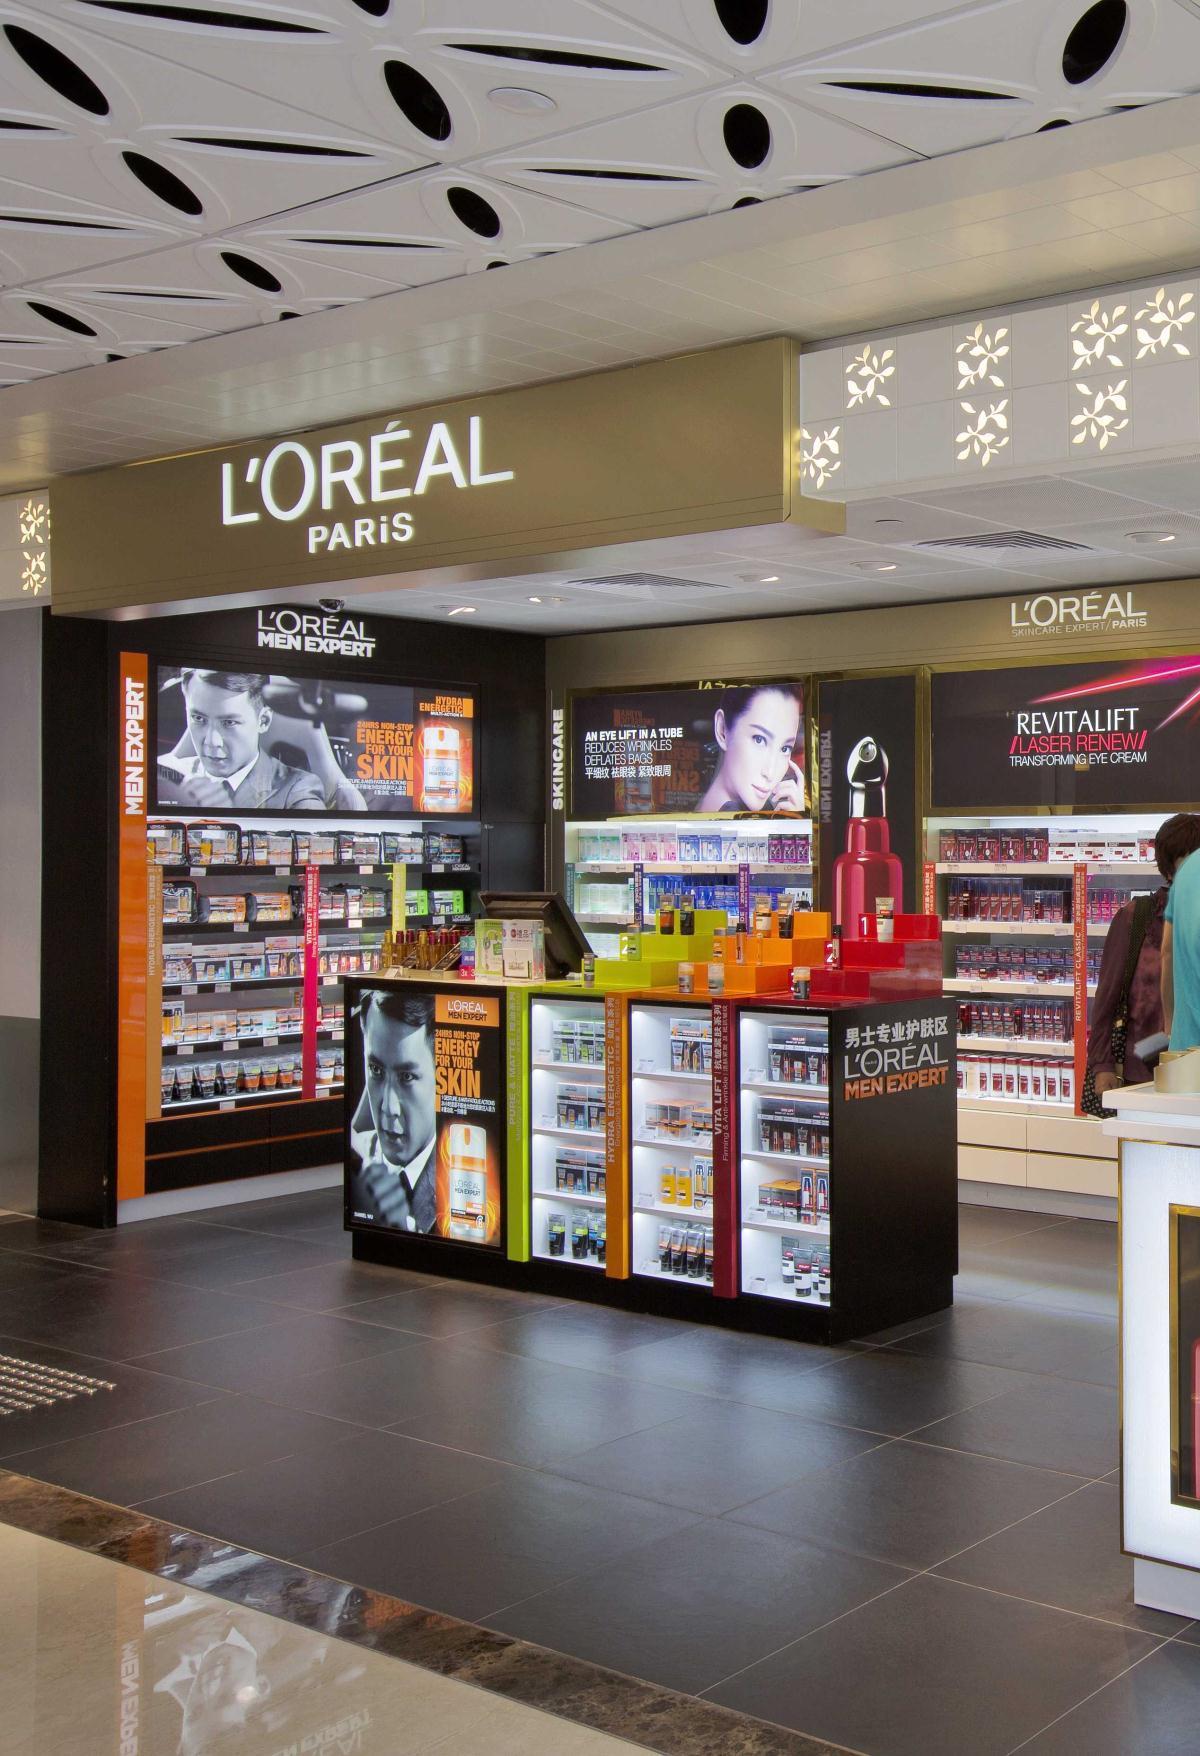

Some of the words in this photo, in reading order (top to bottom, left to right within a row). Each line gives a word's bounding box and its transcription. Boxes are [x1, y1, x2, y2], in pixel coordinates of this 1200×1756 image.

[222, 416, 514, 525] L'ORÉAL
[1011, 592, 1147, 627] L'ORÉAL
[258, 610, 376, 641] L'ORÉAL
[1012, 626, 1062, 638] SKINCARE
[258, 632, 301, 650] MEN
[305, 636, 376, 658] EXPERT
[420, 703, 463, 713] ENERGETIC
[436, 696, 463, 705] HYDRA
[126, 678, 144, 762] EXPERT
[381, 722, 413, 730] NON-STOP
[1018, 708, 1139, 734] REVITALIFT
[357, 729, 413, 745] ENERGY
[585, 732, 597, 741] AN
[600, 731, 616, 740] EYE
[619, 730, 637, 740] LIFT
[639, 730, 648, 739] IN
[650, 729, 657, 738] A
[659, 728, 683, 738] TUBE
[366, 745, 385, 755] FOR
[388, 746, 413, 756] YOUR
[585, 742, 625, 753] REDUCES
[627, 740, 671, 751] WRINKLES
[357, 754, 413, 780] SKIN
[553, 709, 563, 810] SKINCARE
[585, 754, 626, 766] DEFLATES
[629, 754, 652, 764] BAGS
[1010, 754, 1086, 767] TRANSFORMING
[1090, 753, 1108, 764] EYE
[1111, 752, 1147, 763] CREAM
[585, 767, 609, 779] 平细纹
[612, 766, 636, 778] 祛眼袋
[639, 765, 671, 777] 紧致眼周
[126, 766, 144, 815] MEN
[861, 917, 867, 935] 1
[461, 969, 467, 977] 3x
[448, 1000, 487, 1013] L'ORÉAL
[463, 1012, 487, 1021] EXPERT
[454, 1030, 480, 1040] NON-STOP
[845, 1016, 948, 1049] 男士专业护肤区
[435, 1038, 480, 1057] ENERGY
[436, 1055, 450, 1067] FOR
[452, 1056, 473, 1069] YOUR
[845, 1042, 948, 1079] L'ORÉAL
[436, 1066, 480, 1098] SKIN
[714, 1077, 722, 1104] LIFT
[845, 1077, 884, 1101] MEN
[887, 1066, 949, 1094] EXPERT
[714, 1108, 722, 1135] VITA
